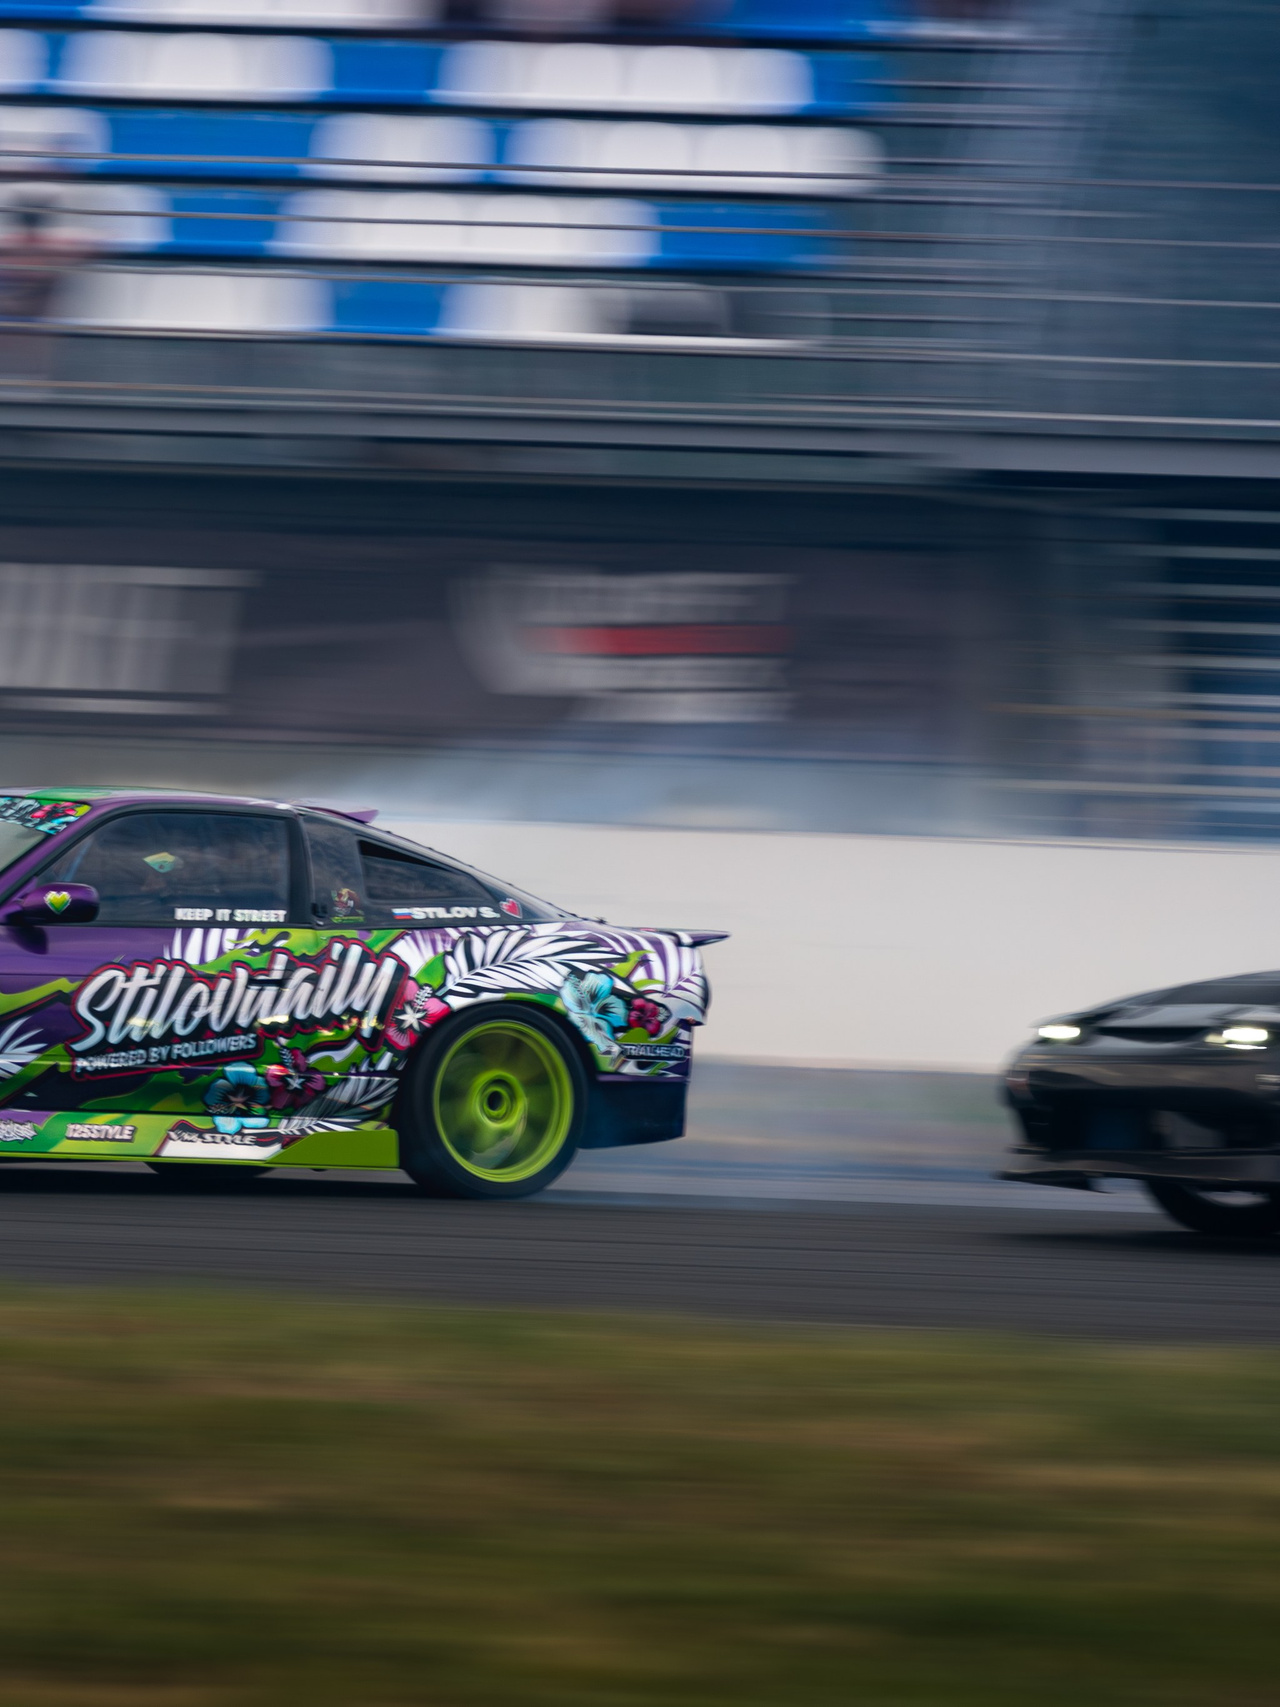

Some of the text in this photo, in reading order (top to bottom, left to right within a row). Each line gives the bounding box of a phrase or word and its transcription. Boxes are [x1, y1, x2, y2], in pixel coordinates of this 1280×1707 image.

[174, 907, 287, 922] KEEP IT STREET
[411, 906, 501, 919] STILOV S.
[74, 1033, 257, 1073] POWERED BY FOLLOWERS
[623, 1045, 685, 1057] TRAILHEAD
[66, 1123, 135, 1141] 125STYLE
